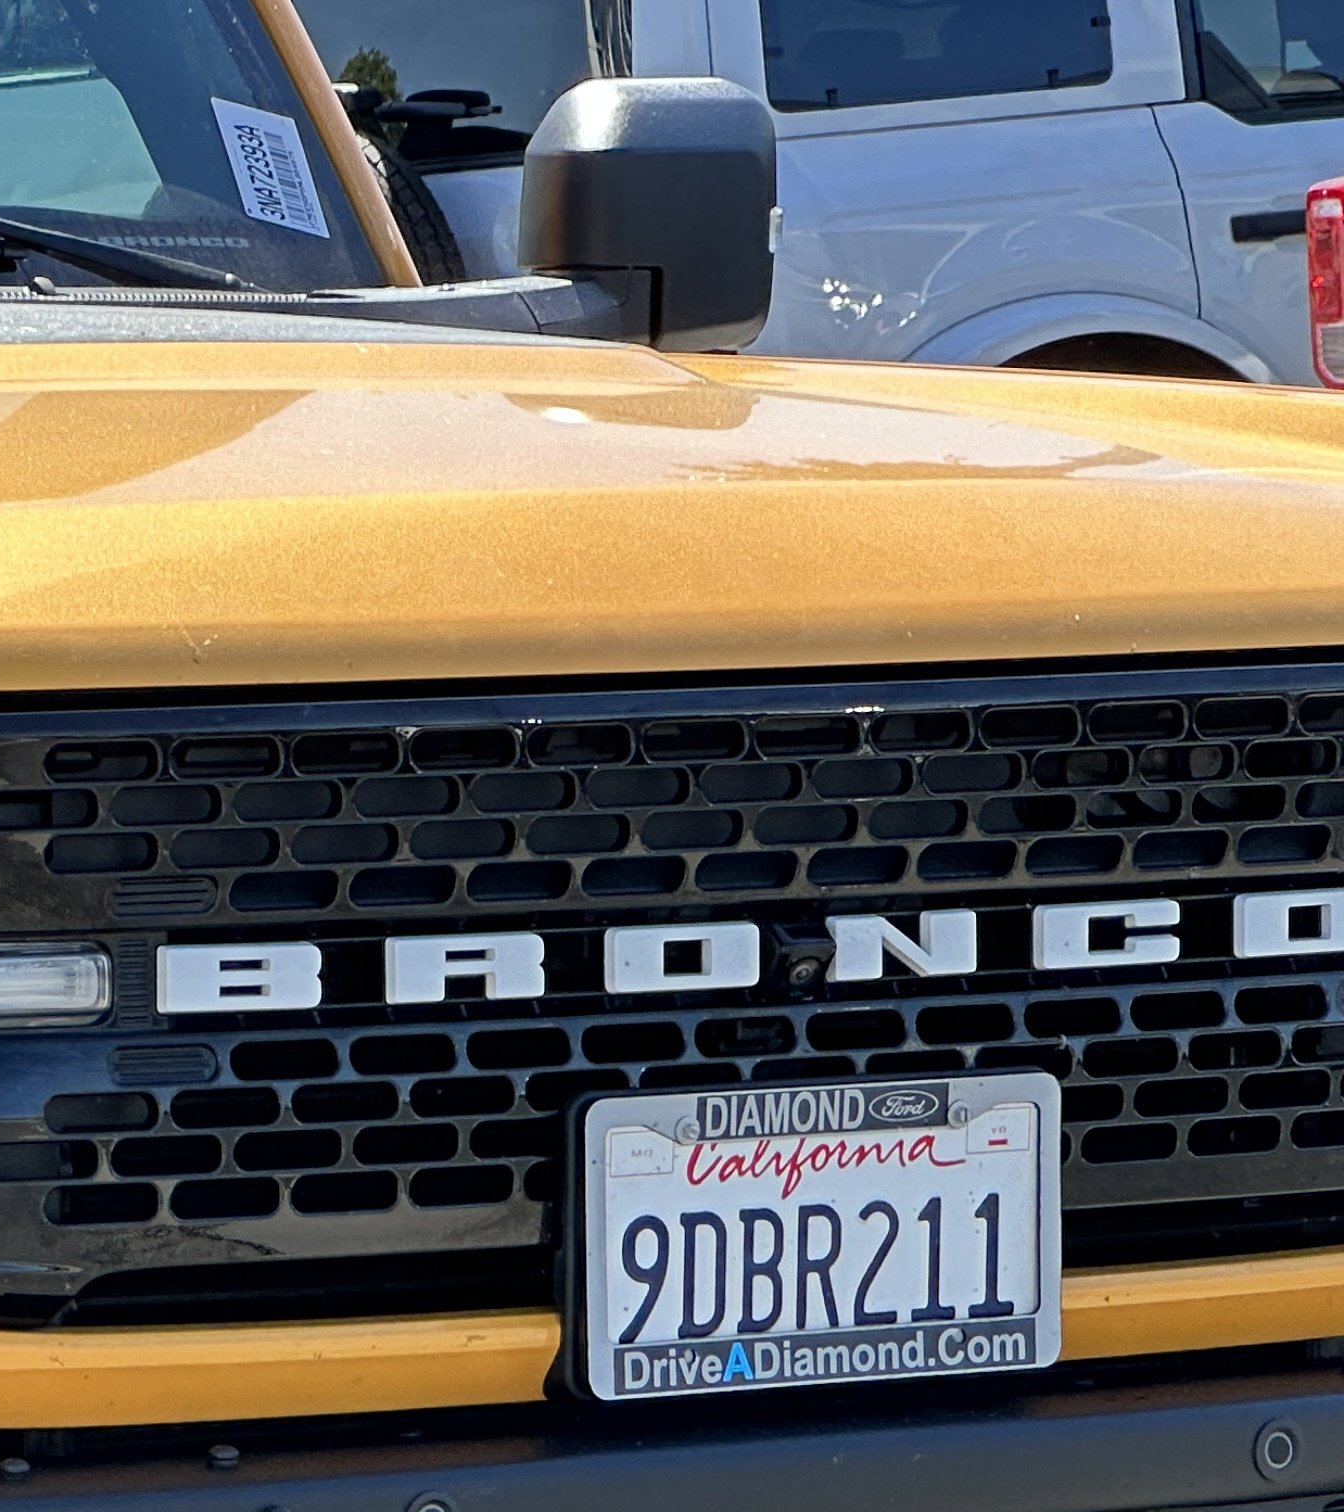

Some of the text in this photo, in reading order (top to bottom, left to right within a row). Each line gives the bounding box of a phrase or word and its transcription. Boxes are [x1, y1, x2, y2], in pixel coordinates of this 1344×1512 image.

[157, 889, 1344, 1014] BRONCO
[704, 1088, 926, 1139] DIAMOND Ford
[686, 1133, 967, 1200] California
[617, 1192, 1015, 1345] 9DBR211
[623, 1329, 1027, 1391] DriveADiamond.Com
